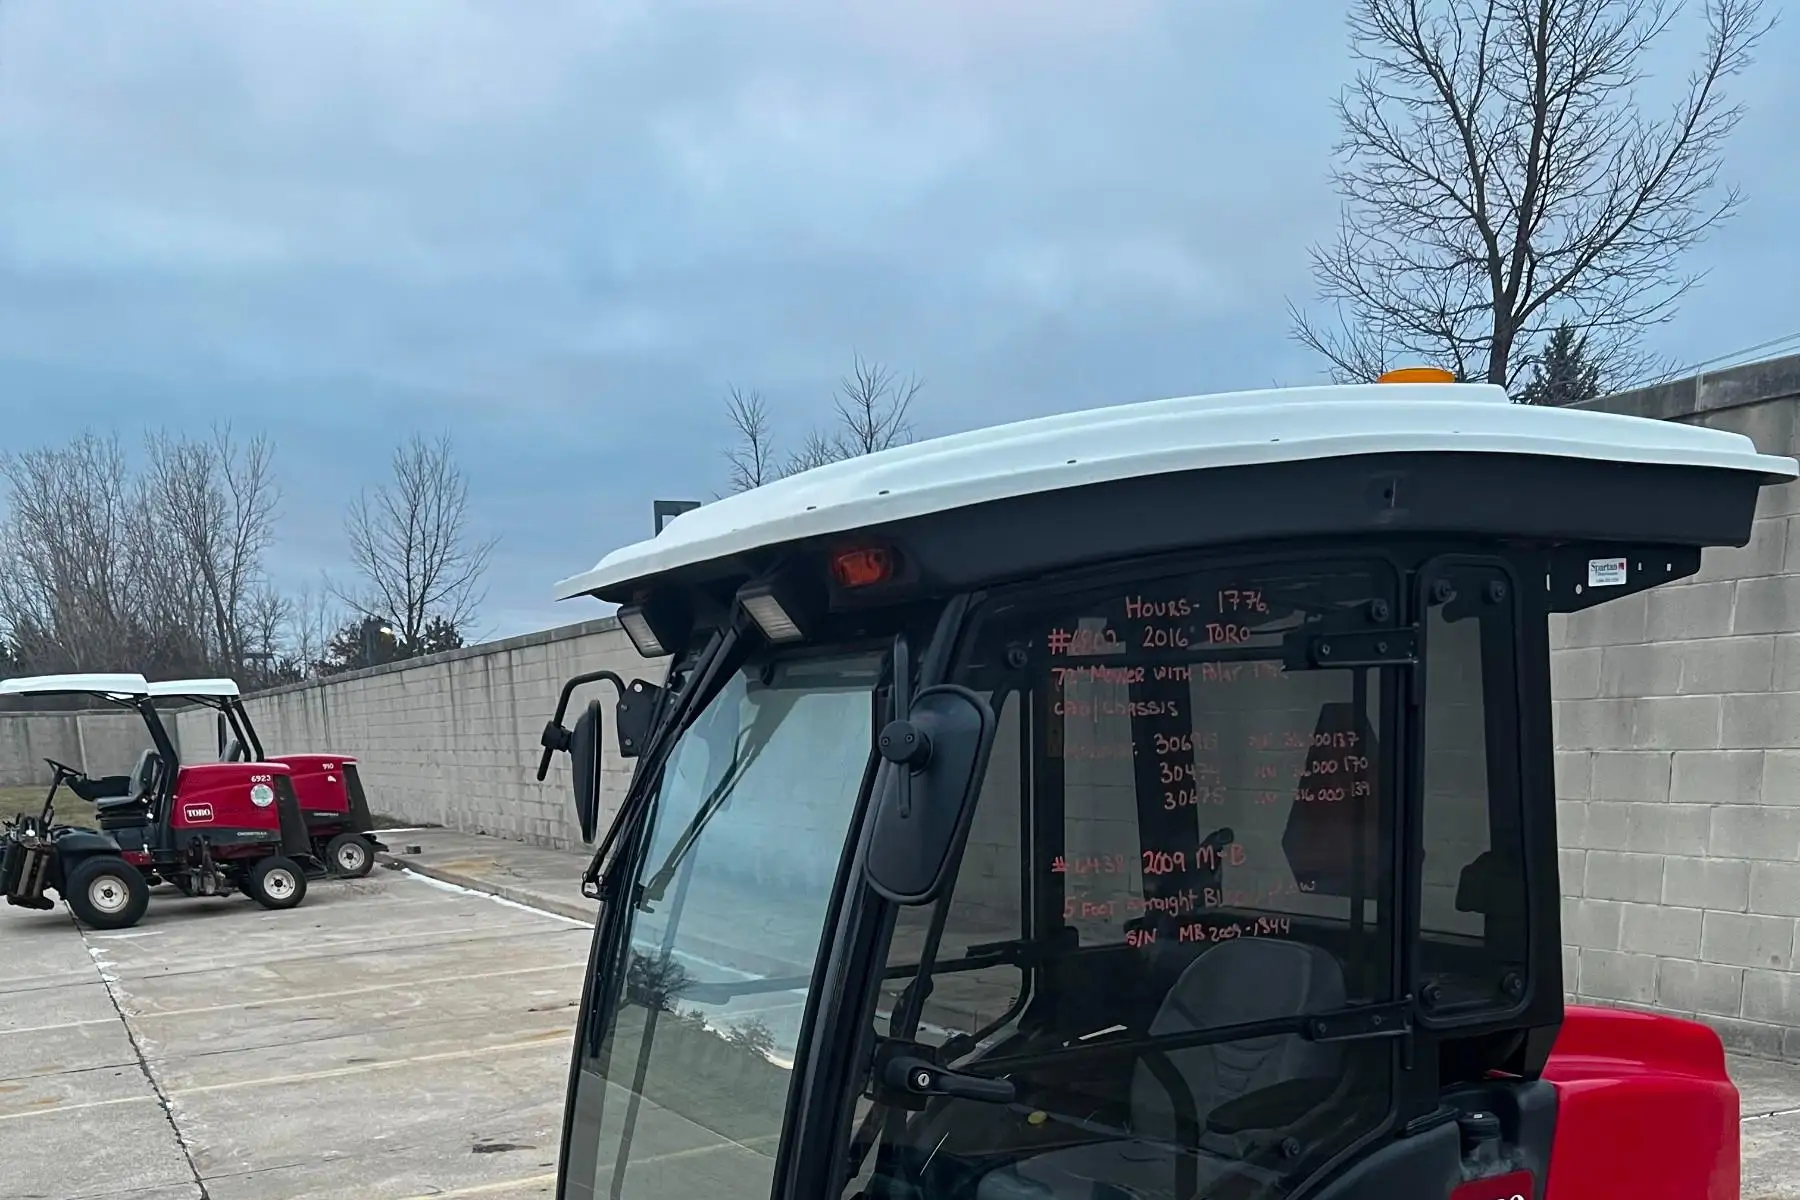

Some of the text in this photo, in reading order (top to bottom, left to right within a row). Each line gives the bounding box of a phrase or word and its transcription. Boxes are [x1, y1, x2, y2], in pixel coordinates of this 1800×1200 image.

[1591, 562, 1617, 574] Spartan
[1142, 625, 1189, 648] 2016
[1205, 623, 1252, 645] TORO
[251, 775, 271, 783] 6923
[186, 808, 212, 817] TORO
[1142, 850, 1187, 875] 2009
